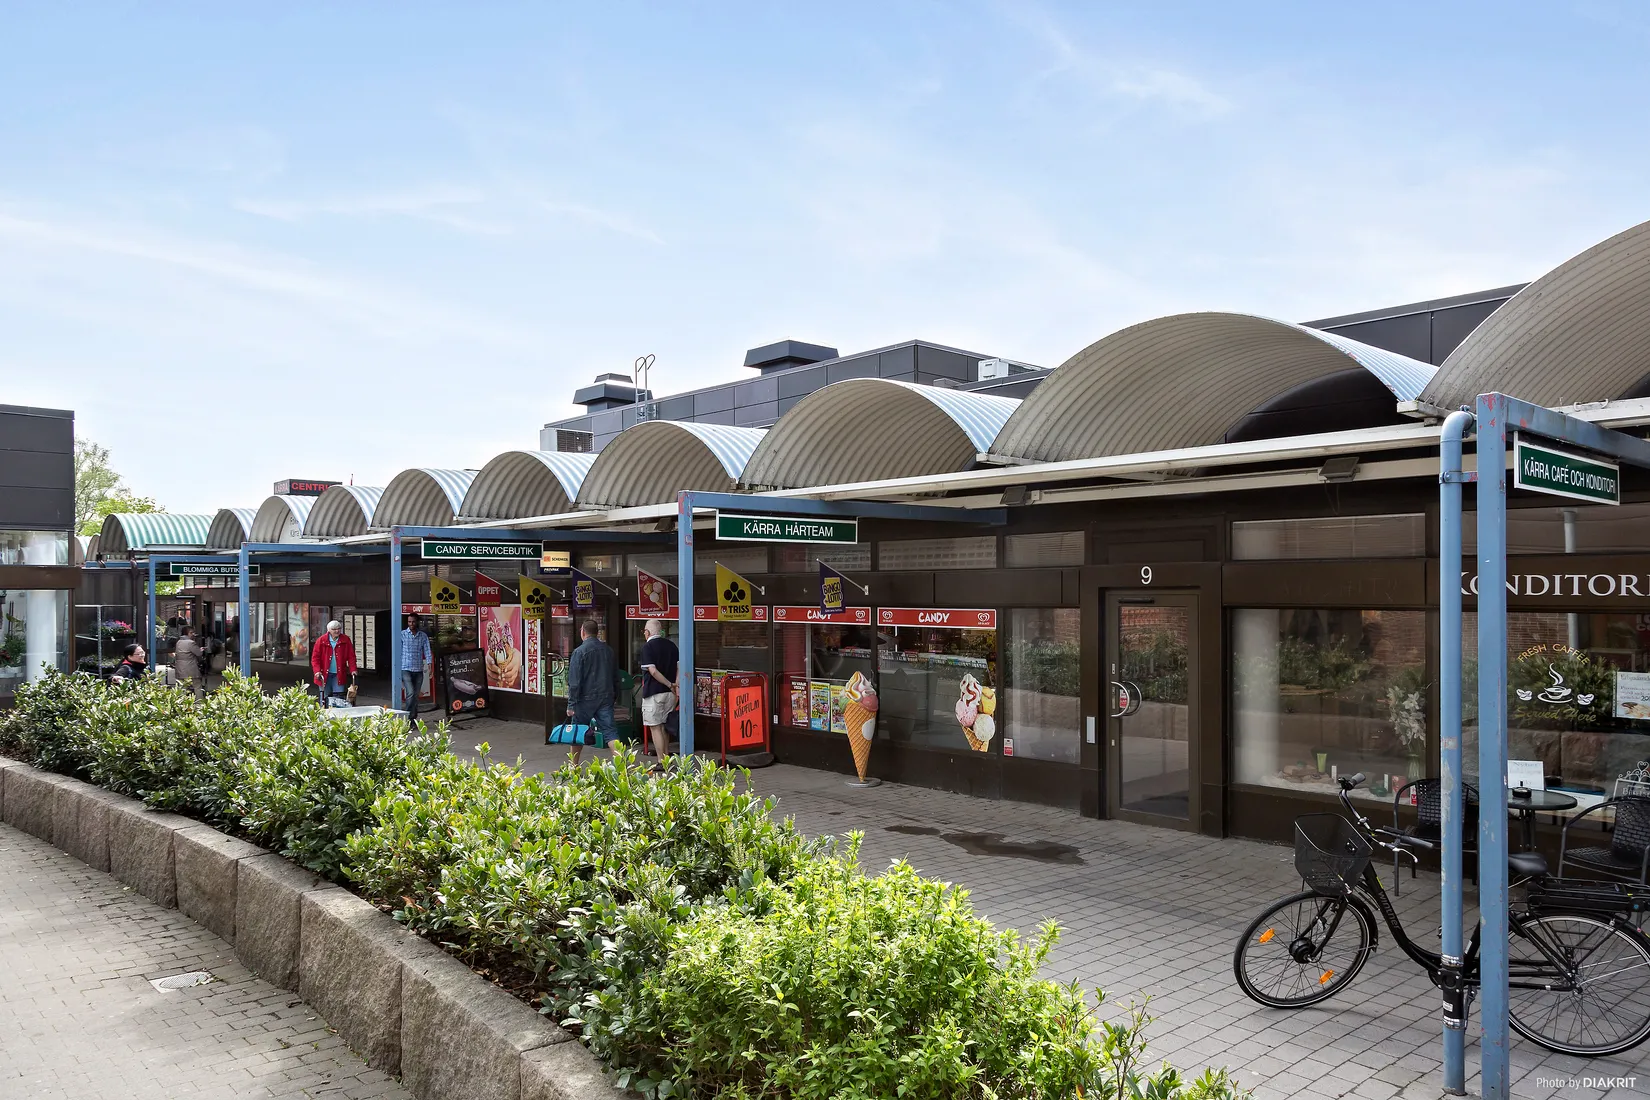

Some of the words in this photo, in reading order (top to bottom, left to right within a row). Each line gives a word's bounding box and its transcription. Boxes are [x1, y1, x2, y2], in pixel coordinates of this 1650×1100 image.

[1525, 457, 1550, 480] KÄRRA
[1551, 465, 1569, 484] CAFÉ
[1570, 470, 1585, 488] OCH
[1586, 474, 1616, 494] KONDITORI
[743, 520, 781, 535] KÄRRA
[785, 522, 833, 537] HÅRTEAM
[435, 545, 468, 554] CANDY
[470, 546, 534, 555] SERVICEBUTIK
[594, 561, 603, 572] 14
[1140, 565, 1152, 585] 9
[478, 586, 499, 595] ÖPPET
[728, 605, 750, 614] TRISS
[918, 612, 950, 623] CANDY
[1517, 643, 1547, 663] FRESH
[1552, 643, 1591, 666] CAFFEE
[450, 658, 471, 667] Stanna
